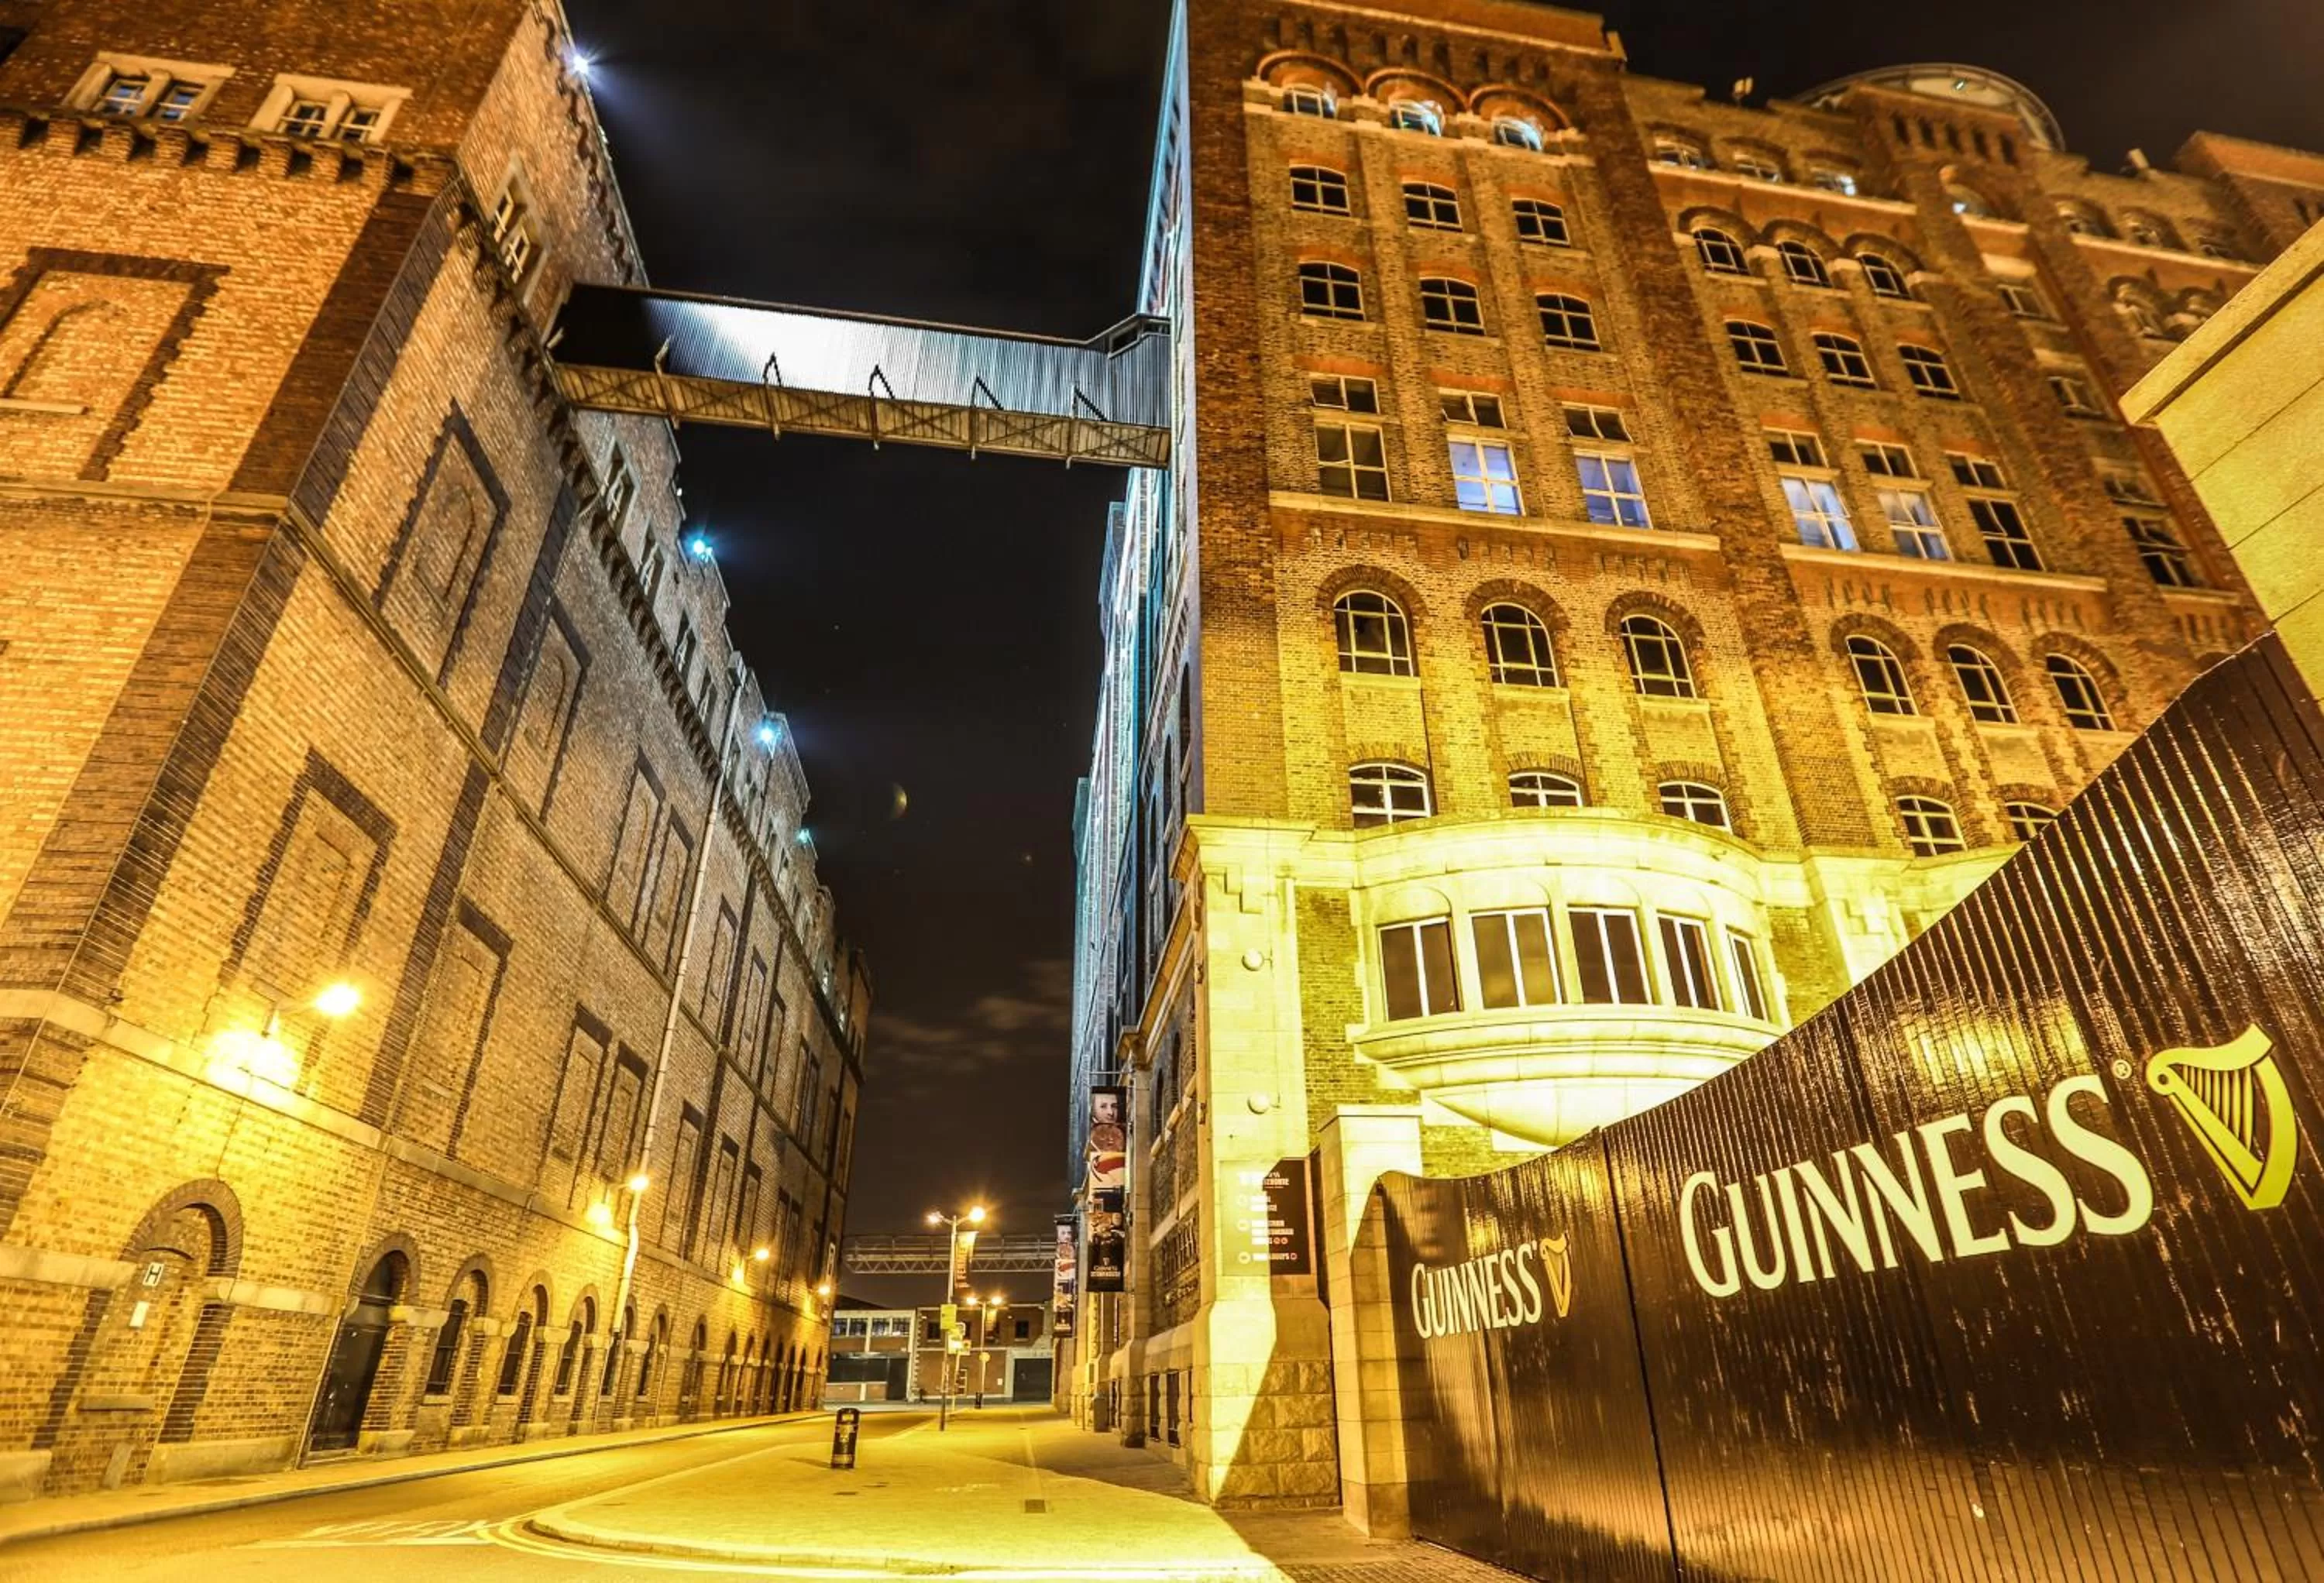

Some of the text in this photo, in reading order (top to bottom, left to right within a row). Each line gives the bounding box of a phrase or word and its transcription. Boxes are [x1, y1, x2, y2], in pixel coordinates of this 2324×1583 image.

[1679, 1074, 2154, 1298] GUINNESS
[146, 1265, 162, 1285] H
[1411, 1241, 1543, 1339] GUINNESS
